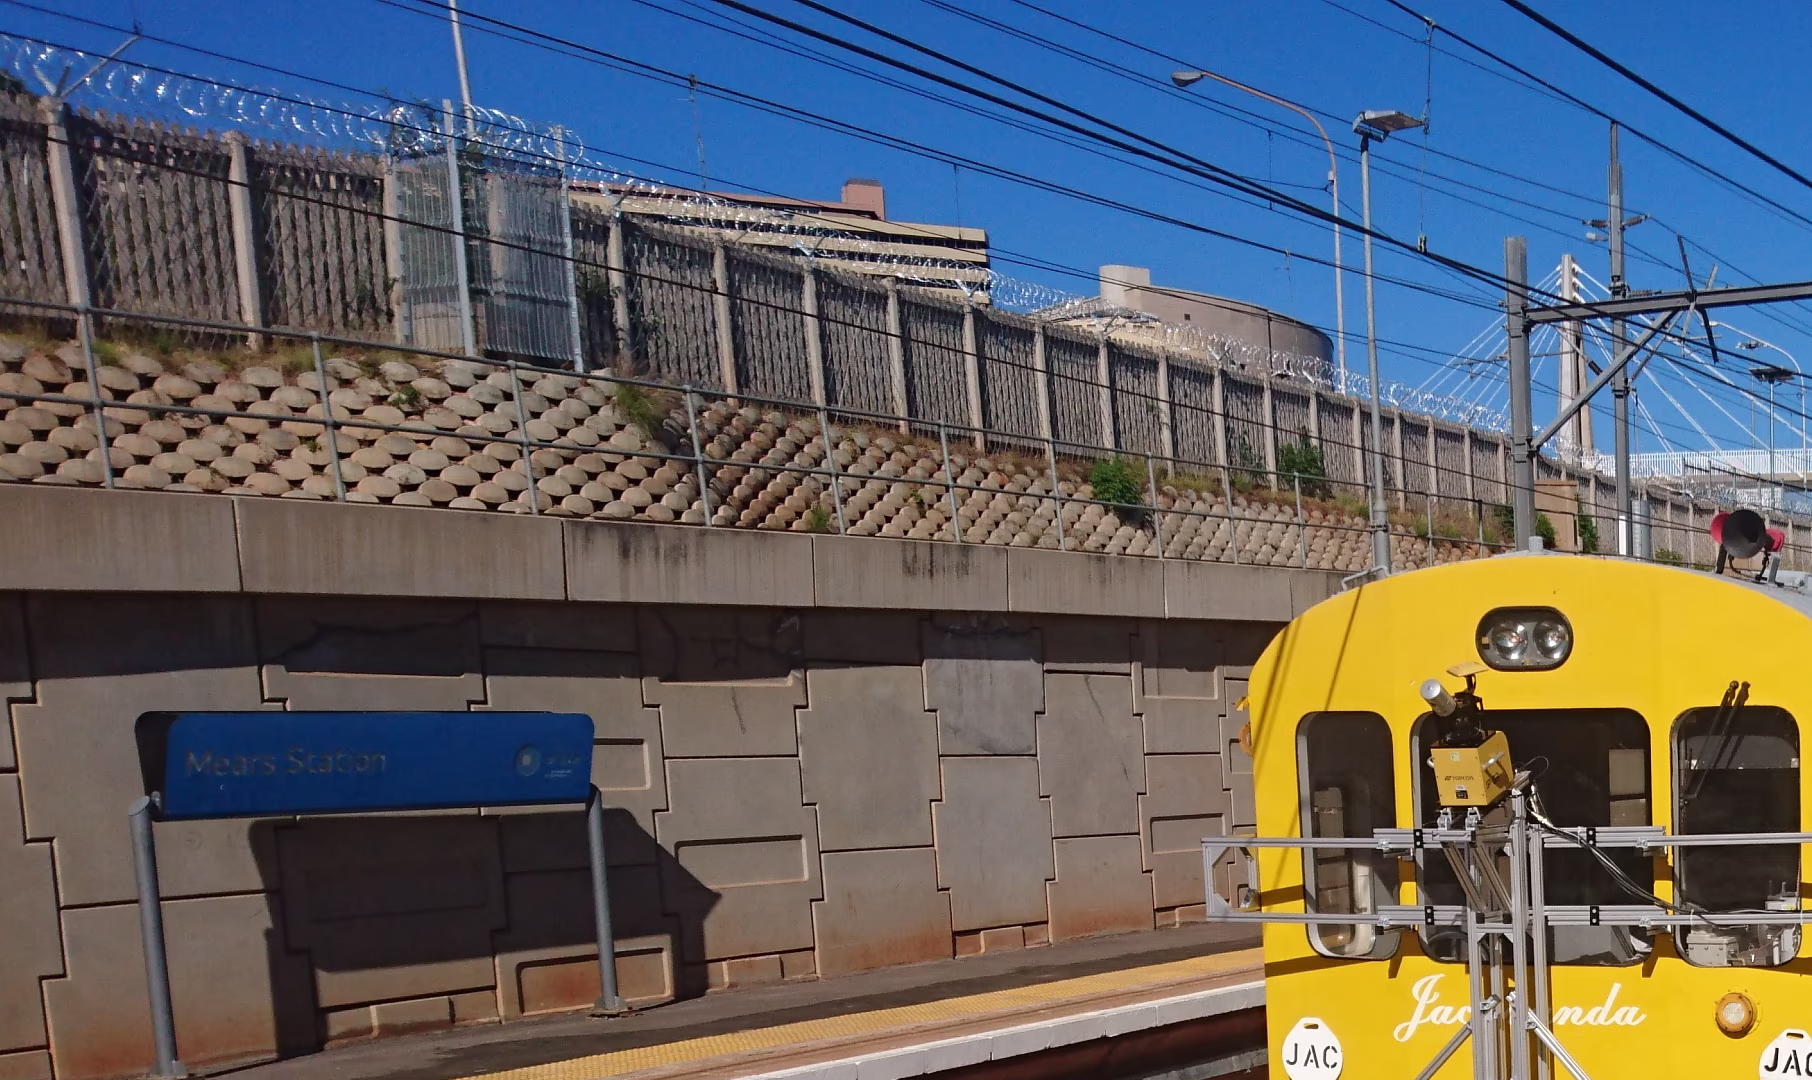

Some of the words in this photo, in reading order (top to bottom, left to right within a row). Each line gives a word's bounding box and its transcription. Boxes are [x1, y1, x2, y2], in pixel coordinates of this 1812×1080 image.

[184, 750, 276, 777] Mears
[286, 746, 387, 776] Station
[1392, 973, 1647, 1043] Jacnda
[1285, 1042, 1338, 1069] JAC
